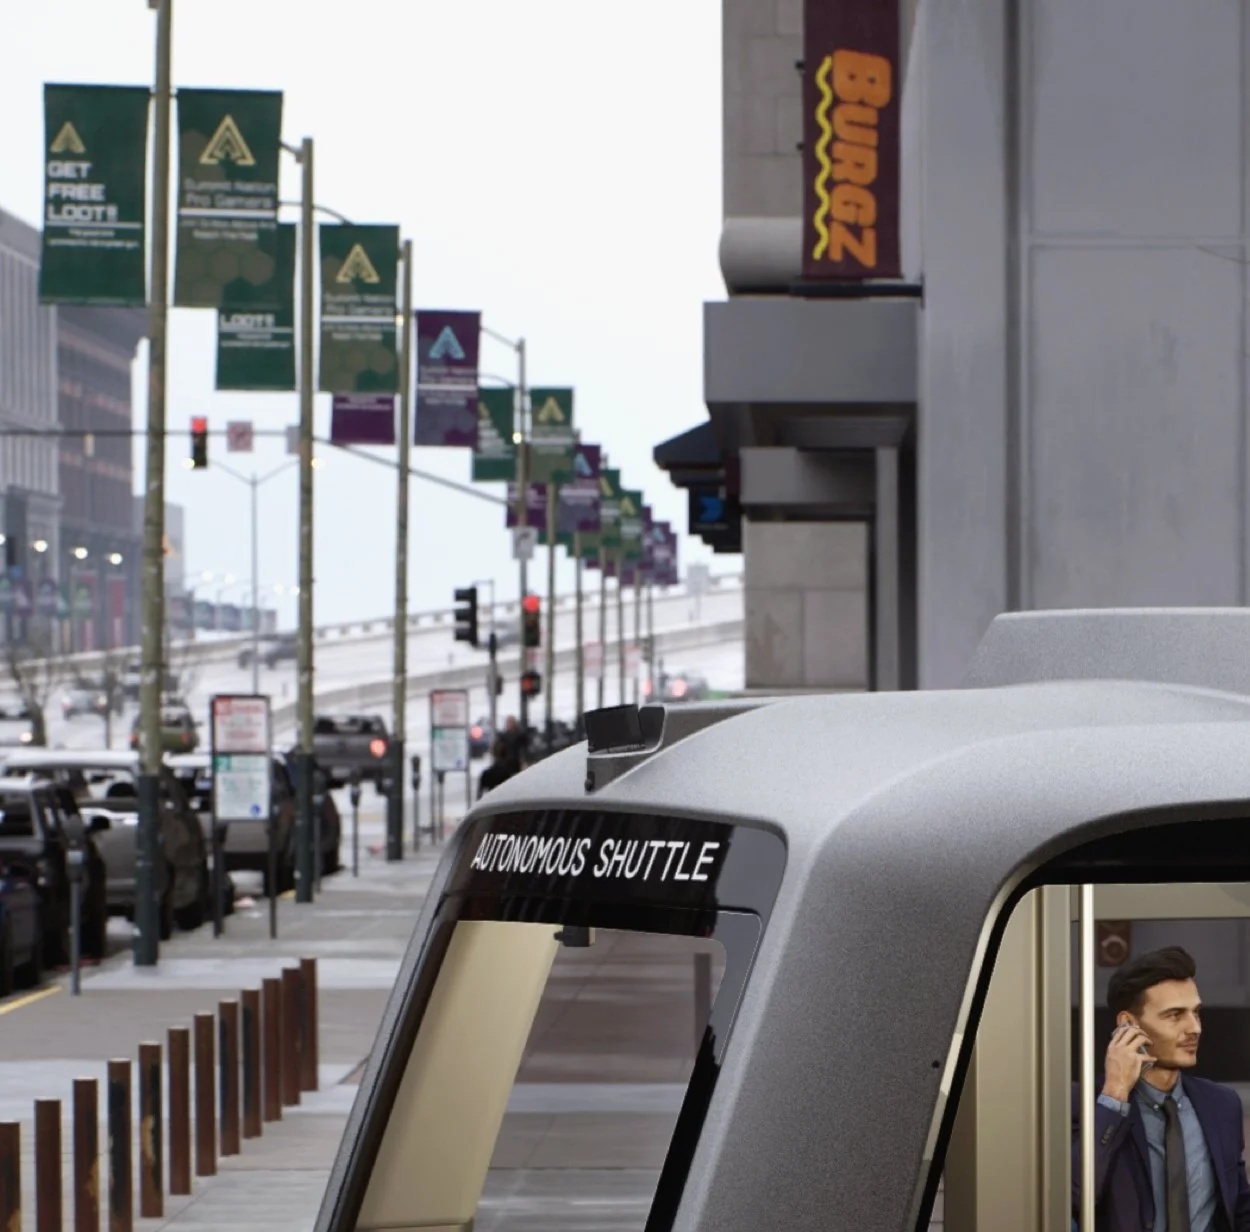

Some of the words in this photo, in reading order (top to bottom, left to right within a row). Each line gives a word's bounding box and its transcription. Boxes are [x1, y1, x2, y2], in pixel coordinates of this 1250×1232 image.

[47, 160, 91, 178] GET
[829, 48, 893, 268] BURGZ
[47, 183, 106, 202] FREE
[470, 832, 591, 877] AUTONOMOUS
[593, 838, 720, 882] SHUTTLE
